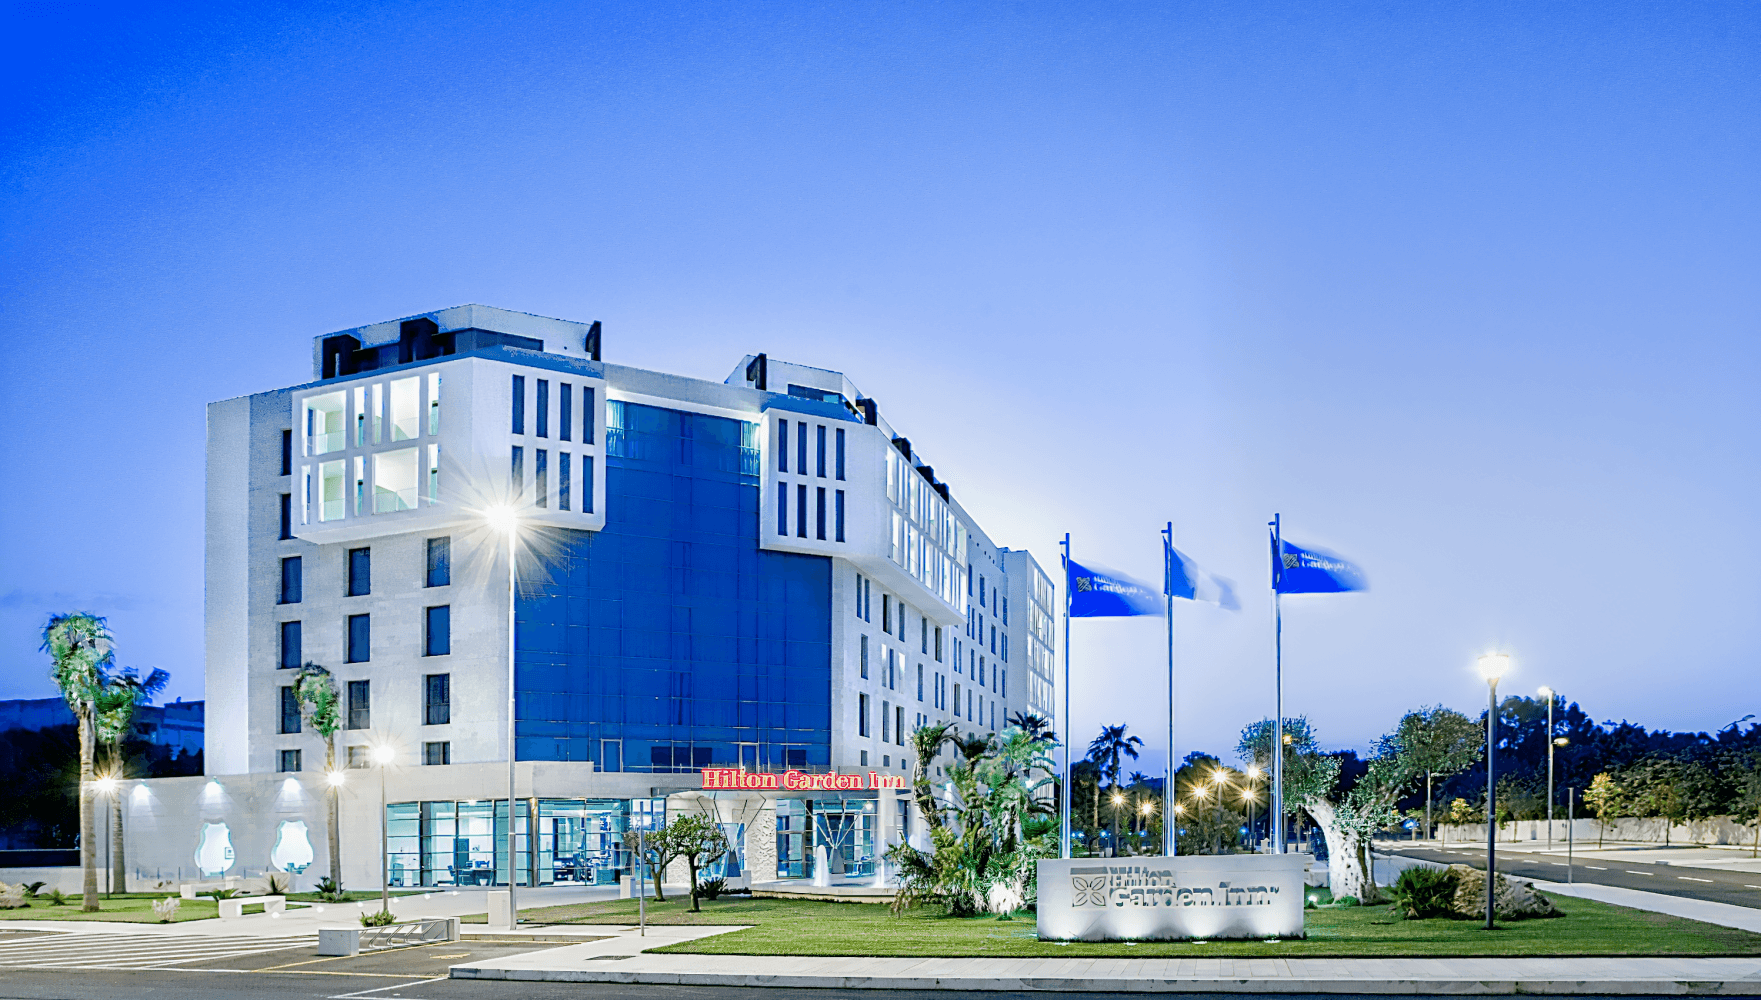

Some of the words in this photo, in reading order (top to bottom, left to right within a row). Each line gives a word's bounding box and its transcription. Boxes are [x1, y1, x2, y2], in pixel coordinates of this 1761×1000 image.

[702, 769, 779, 789] Hilton
[783, 770, 863, 790] Garden
[868, 771, 905, 789] Inn
[1110, 868, 1175, 888] Hilton
[1110, 887, 1214, 907] Garden
